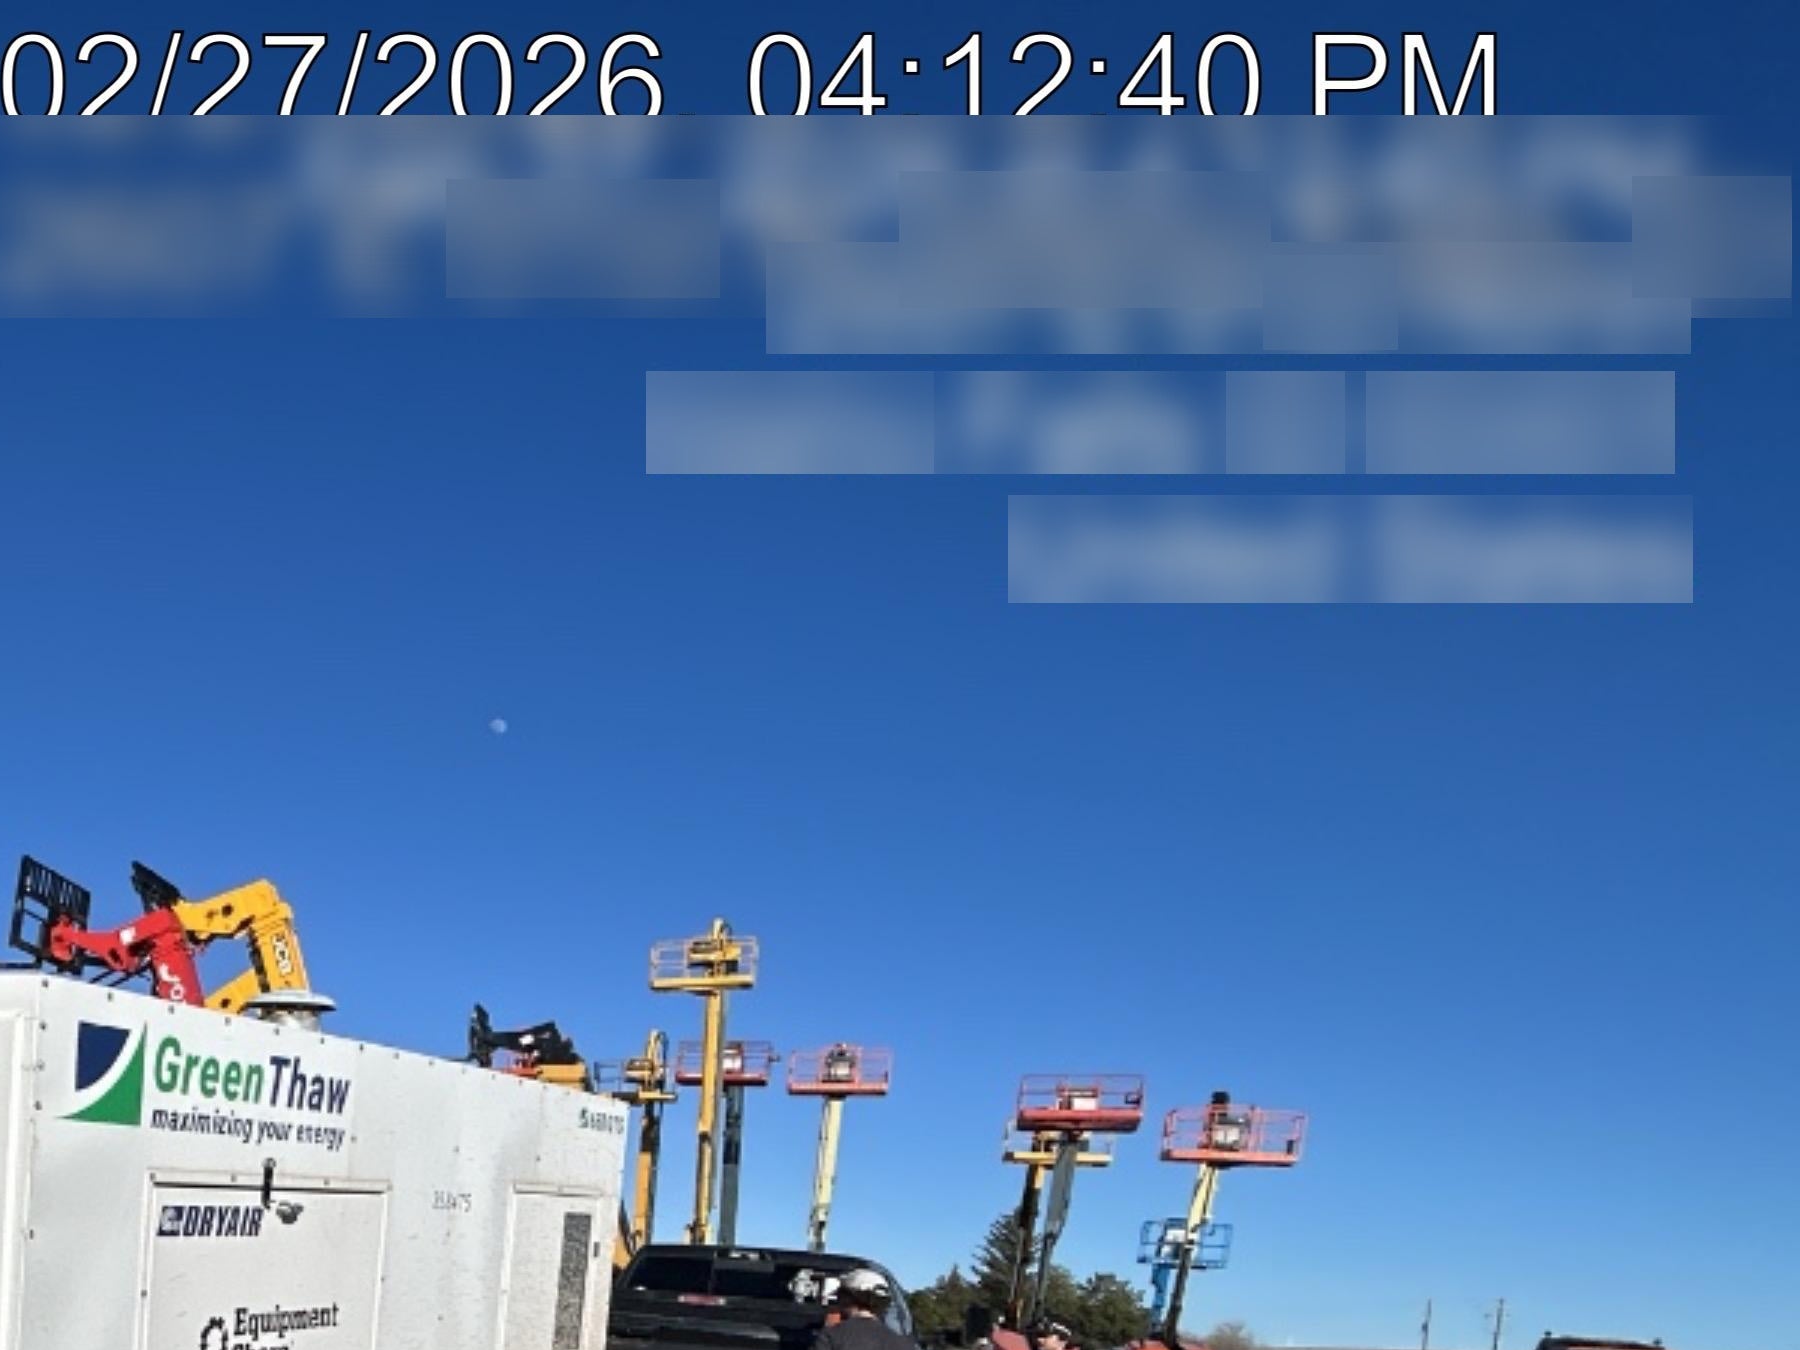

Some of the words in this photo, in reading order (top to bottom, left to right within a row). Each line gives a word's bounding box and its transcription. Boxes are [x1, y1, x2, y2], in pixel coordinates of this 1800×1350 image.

[150, 1106, 253, 1144] maximizing
[256, 1118, 293, 1146] your
[296, 1123, 346, 1152] energy
[181, 1205, 265, 1237] DRYAIR
[233, 1302, 340, 1341] Equipment
